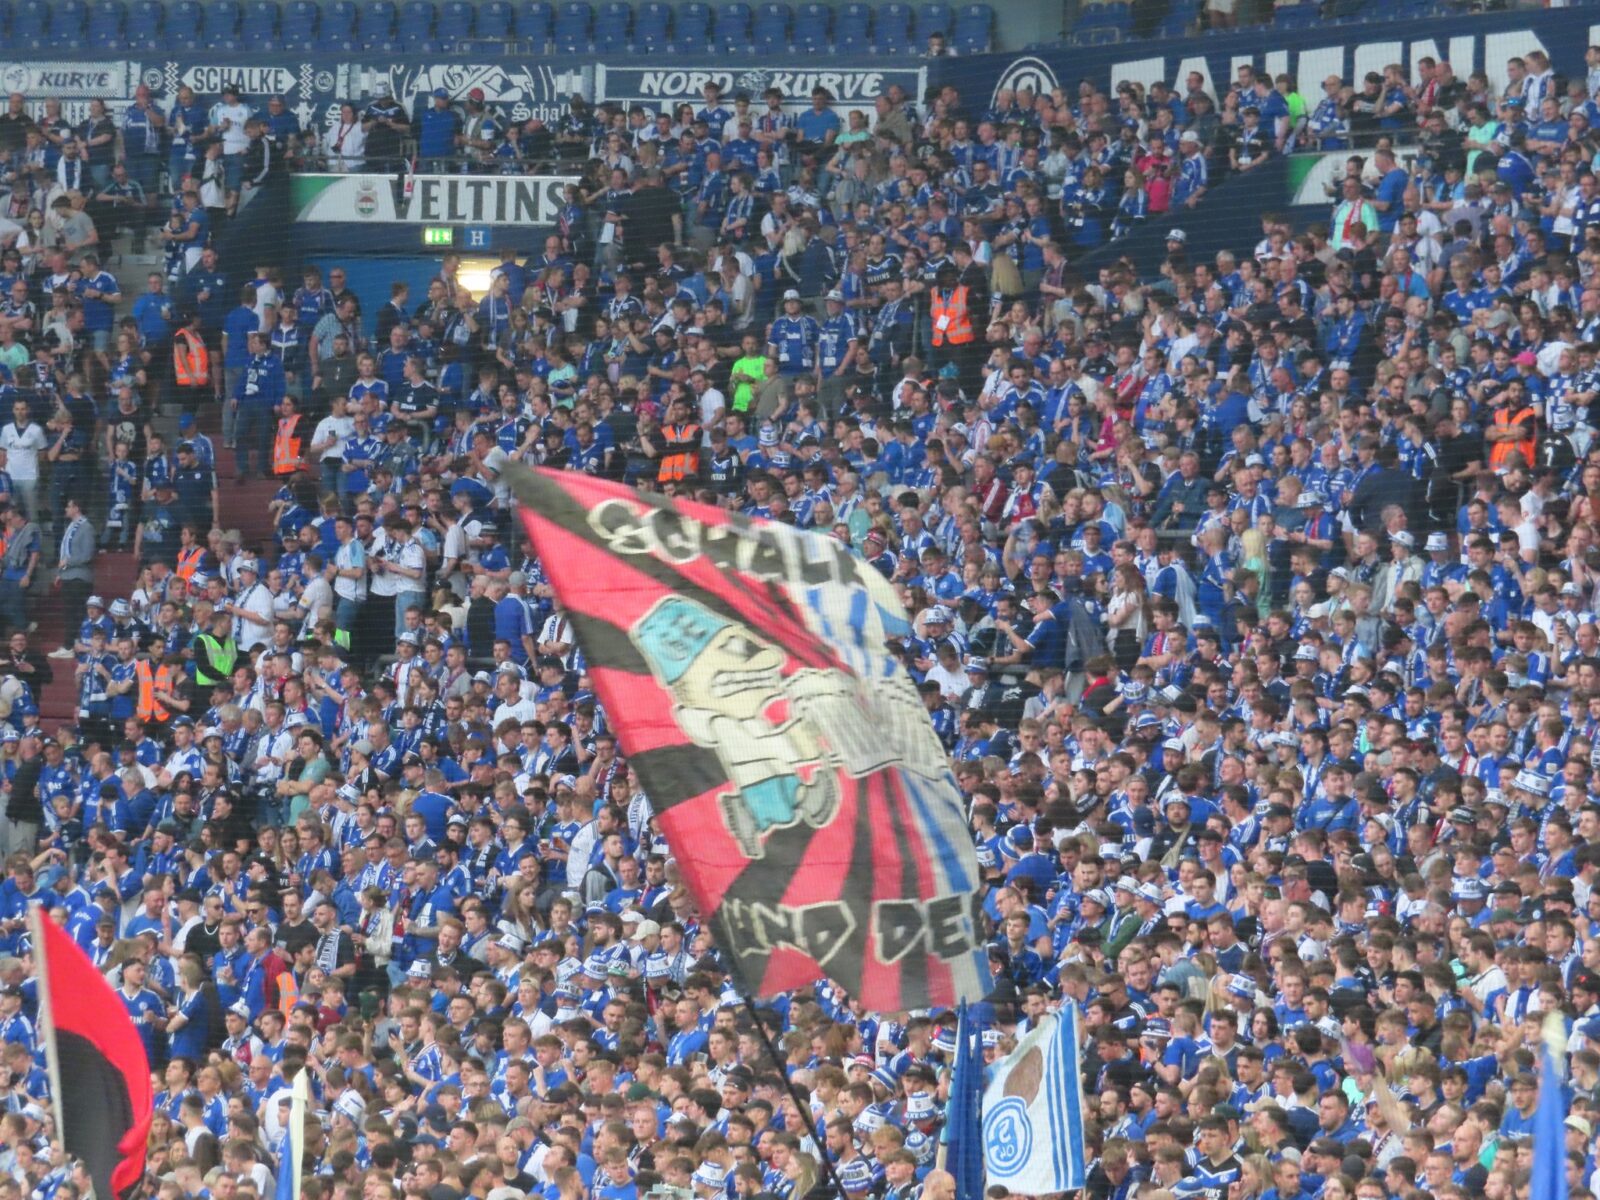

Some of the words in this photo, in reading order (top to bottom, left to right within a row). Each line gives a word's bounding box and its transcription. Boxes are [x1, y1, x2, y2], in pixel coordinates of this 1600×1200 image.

[39, 72, 109, 88] KURVE
[193, 67, 284, 92] SCHALKE
[639, 71, 733, 96] NORD
[770, 72, 883, 101] KURVE
[389, 179, 567, 222] VELTINS
[471, 230, 485, 246] H
